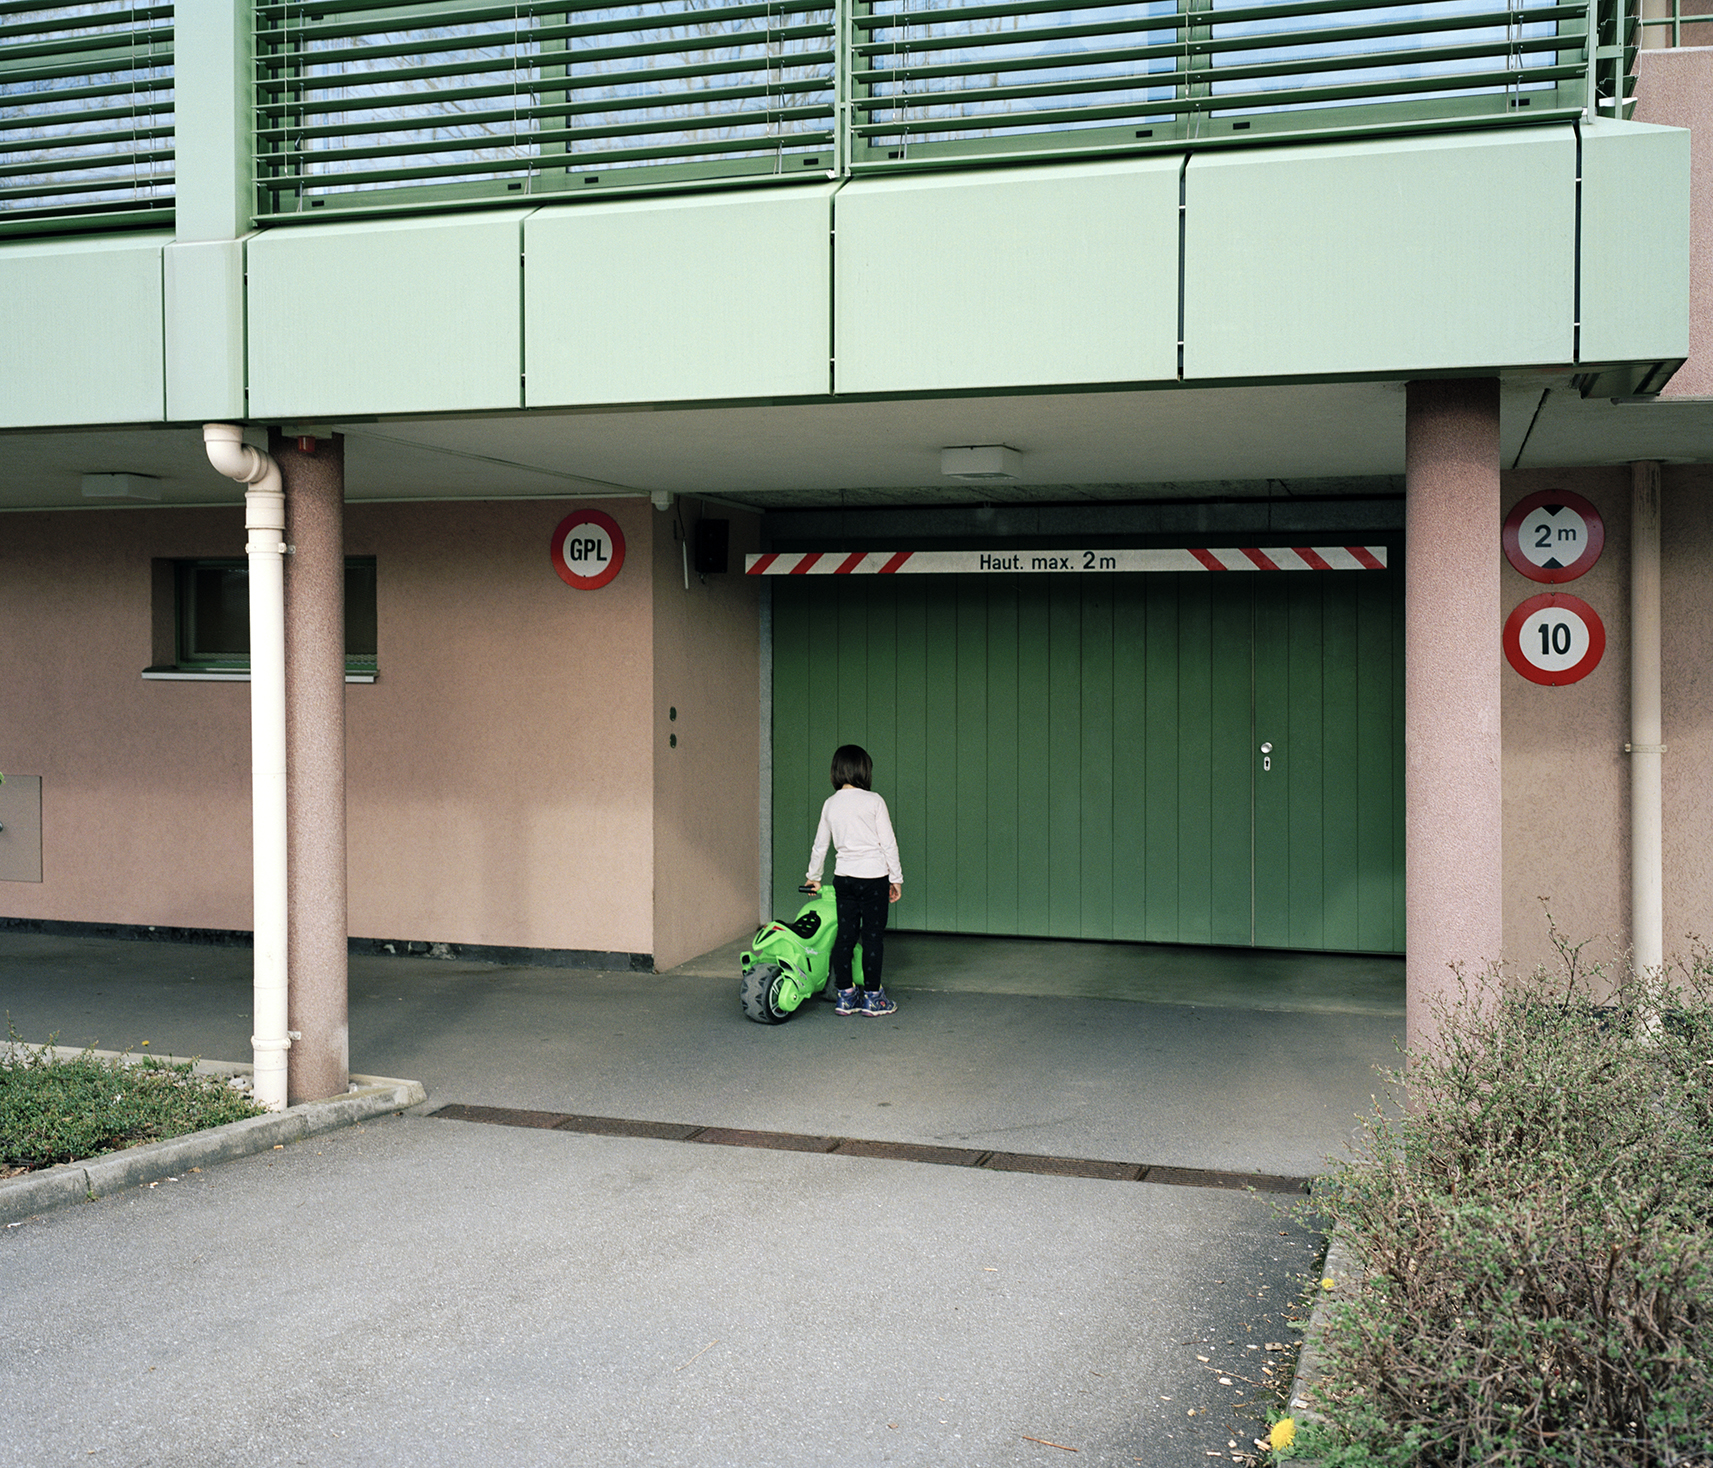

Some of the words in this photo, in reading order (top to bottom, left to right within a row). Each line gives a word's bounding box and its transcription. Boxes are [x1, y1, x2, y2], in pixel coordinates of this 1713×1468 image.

[570, 538, 608, 562] GPL
[980, 554, 1024, 570] Haut.
[1031, 556, 1074, 570] max.
[1538, 622, 1571, 655] 10
